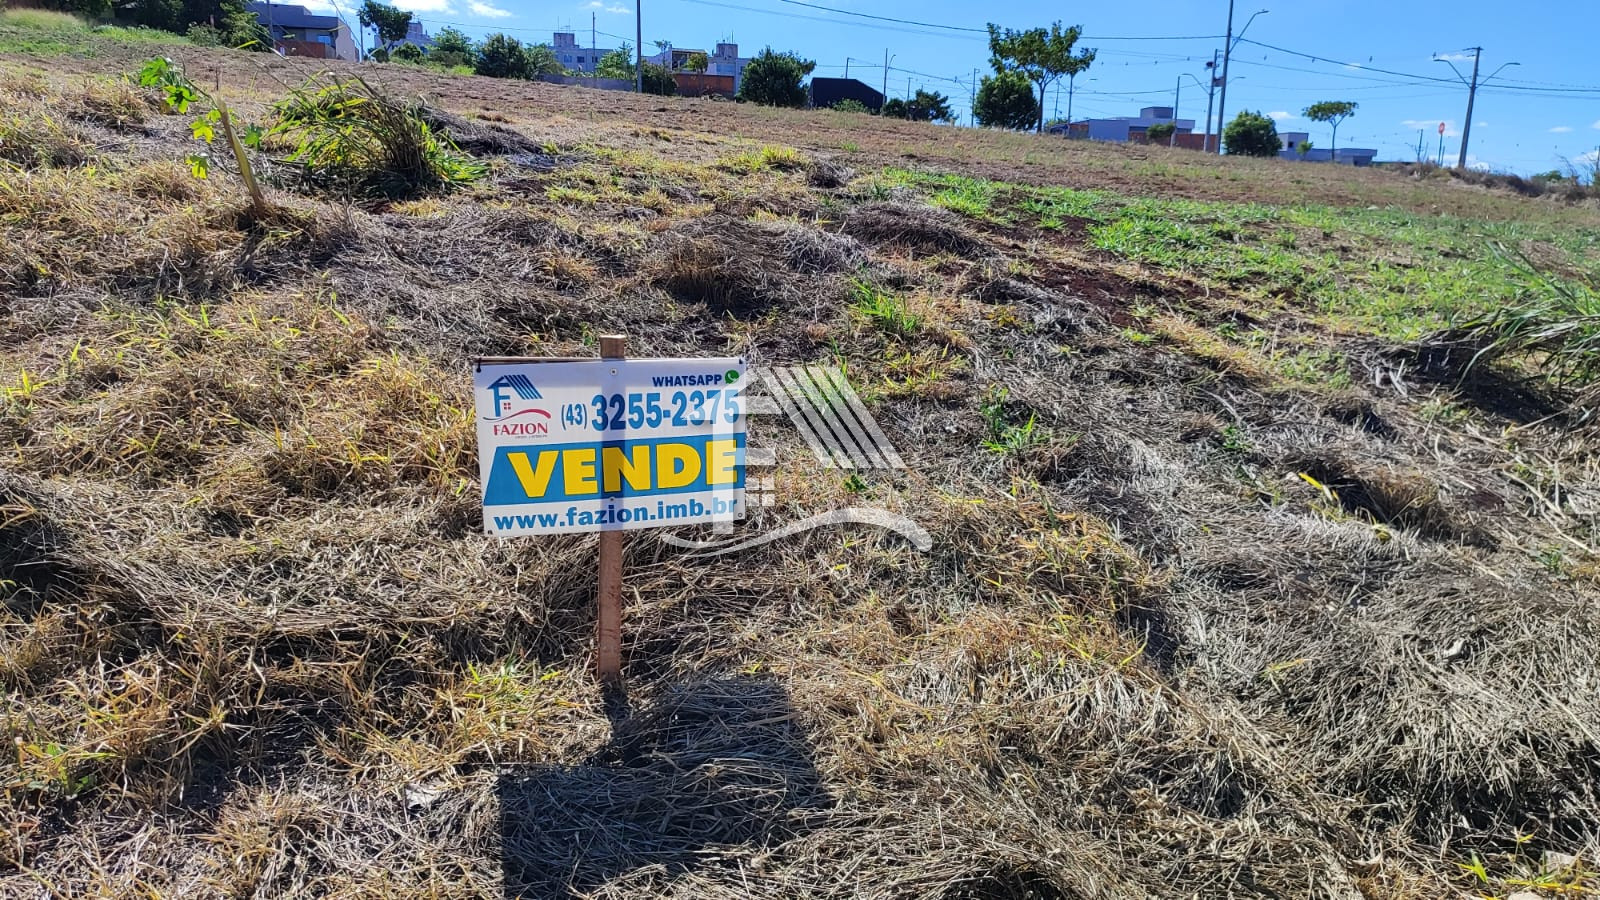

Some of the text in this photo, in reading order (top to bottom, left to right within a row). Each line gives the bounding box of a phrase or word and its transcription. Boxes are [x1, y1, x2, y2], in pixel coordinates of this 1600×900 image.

[652, 374, 722, 387] WHATSAPP
[561, 389, 740, 432] (43) 3255-2375
[493, 422, 549, 436] FAZION
[507, 439, 738, 498] VENDE
[494, 498, 738, 530] www.fazion.imb.br
